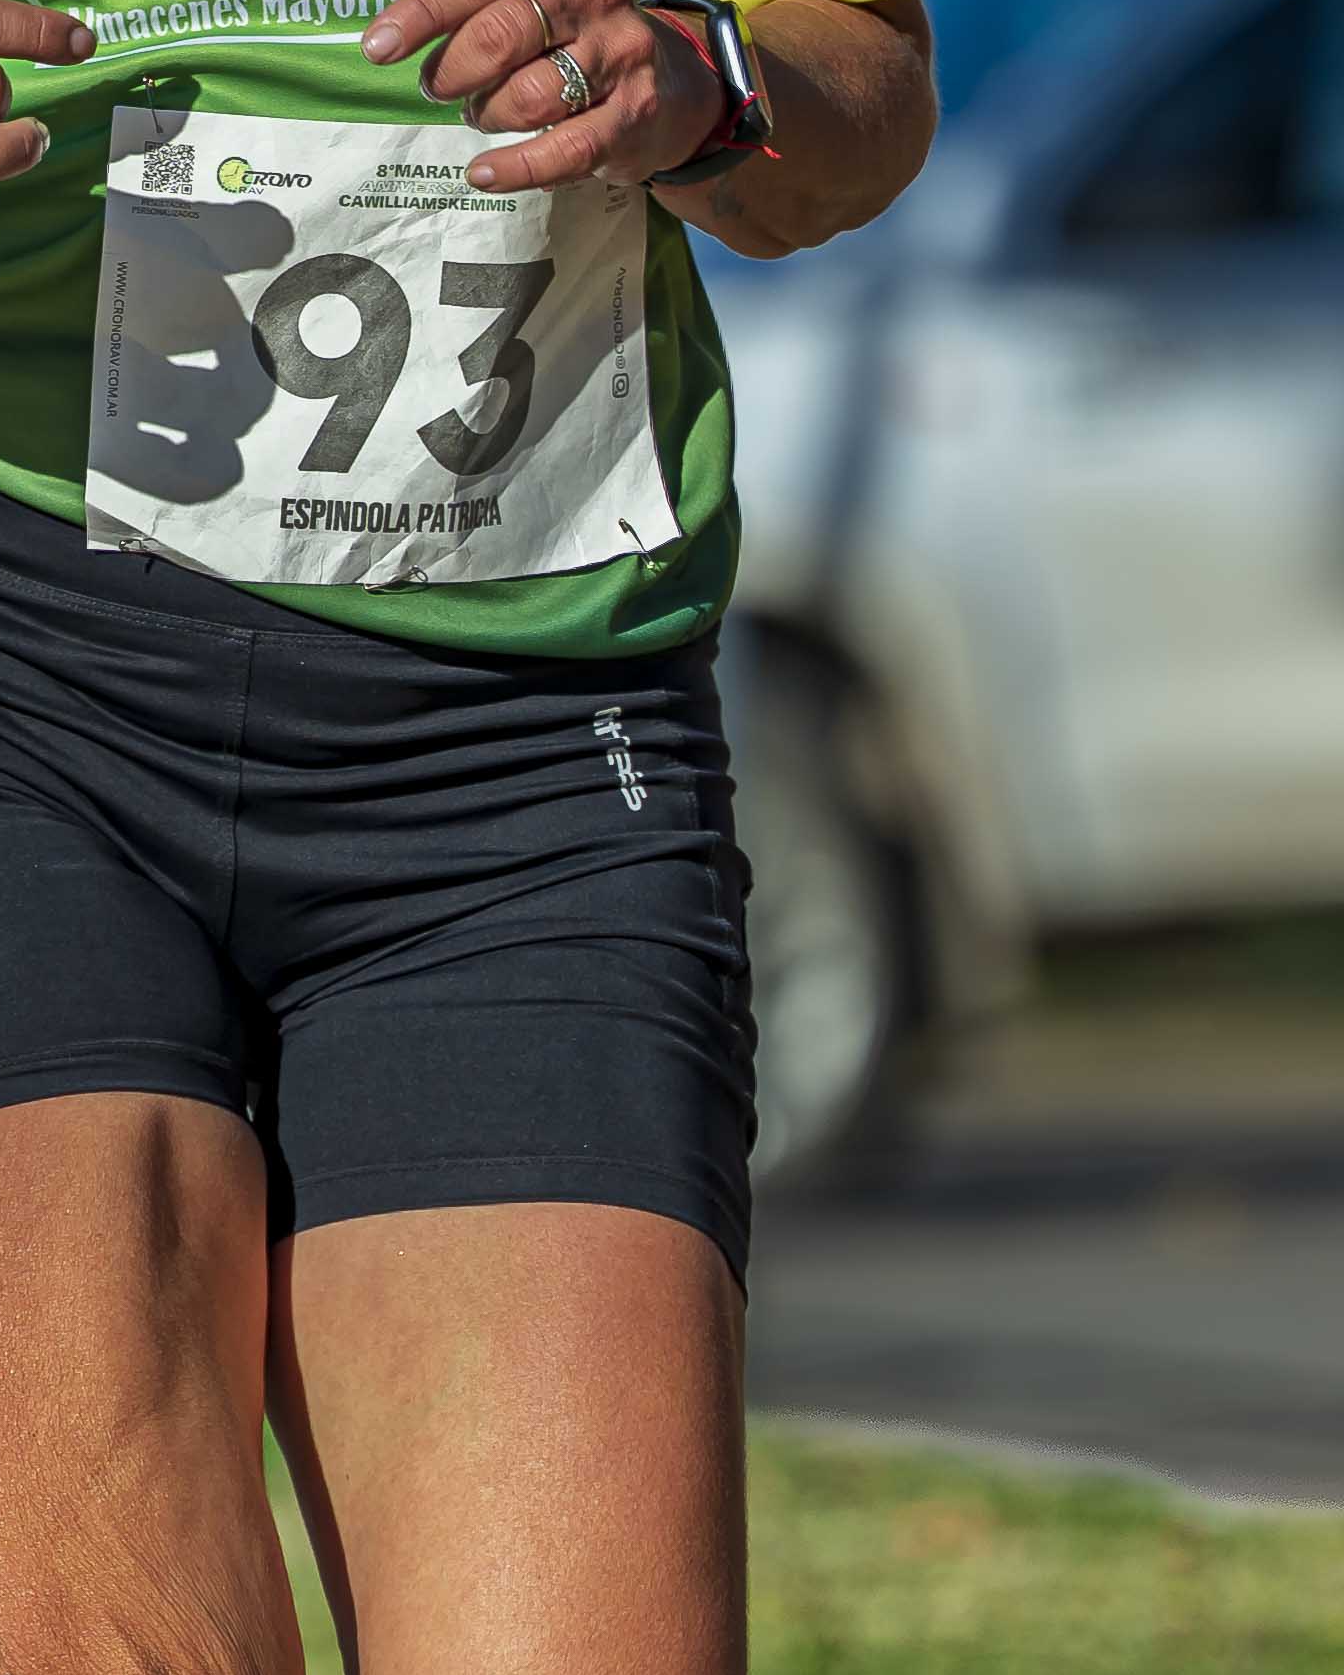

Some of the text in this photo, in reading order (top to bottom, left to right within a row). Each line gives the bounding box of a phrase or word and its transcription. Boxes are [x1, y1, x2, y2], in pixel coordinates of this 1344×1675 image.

[357, 180, 490, 195] ANIVERSA
[375, 164, 465, 180] 8°MARAT
[338, 194, 517, 212] CAWILLIAMSKEMMIS
[611, 266, 627, 369] @CRONORAV
[106, 261, 129, 418] WWW.CRONORAV.COM.AR
[252, 253, 555, 477] 93
[279, 495, 503, 533] ESPINDOLA PATRICIA
